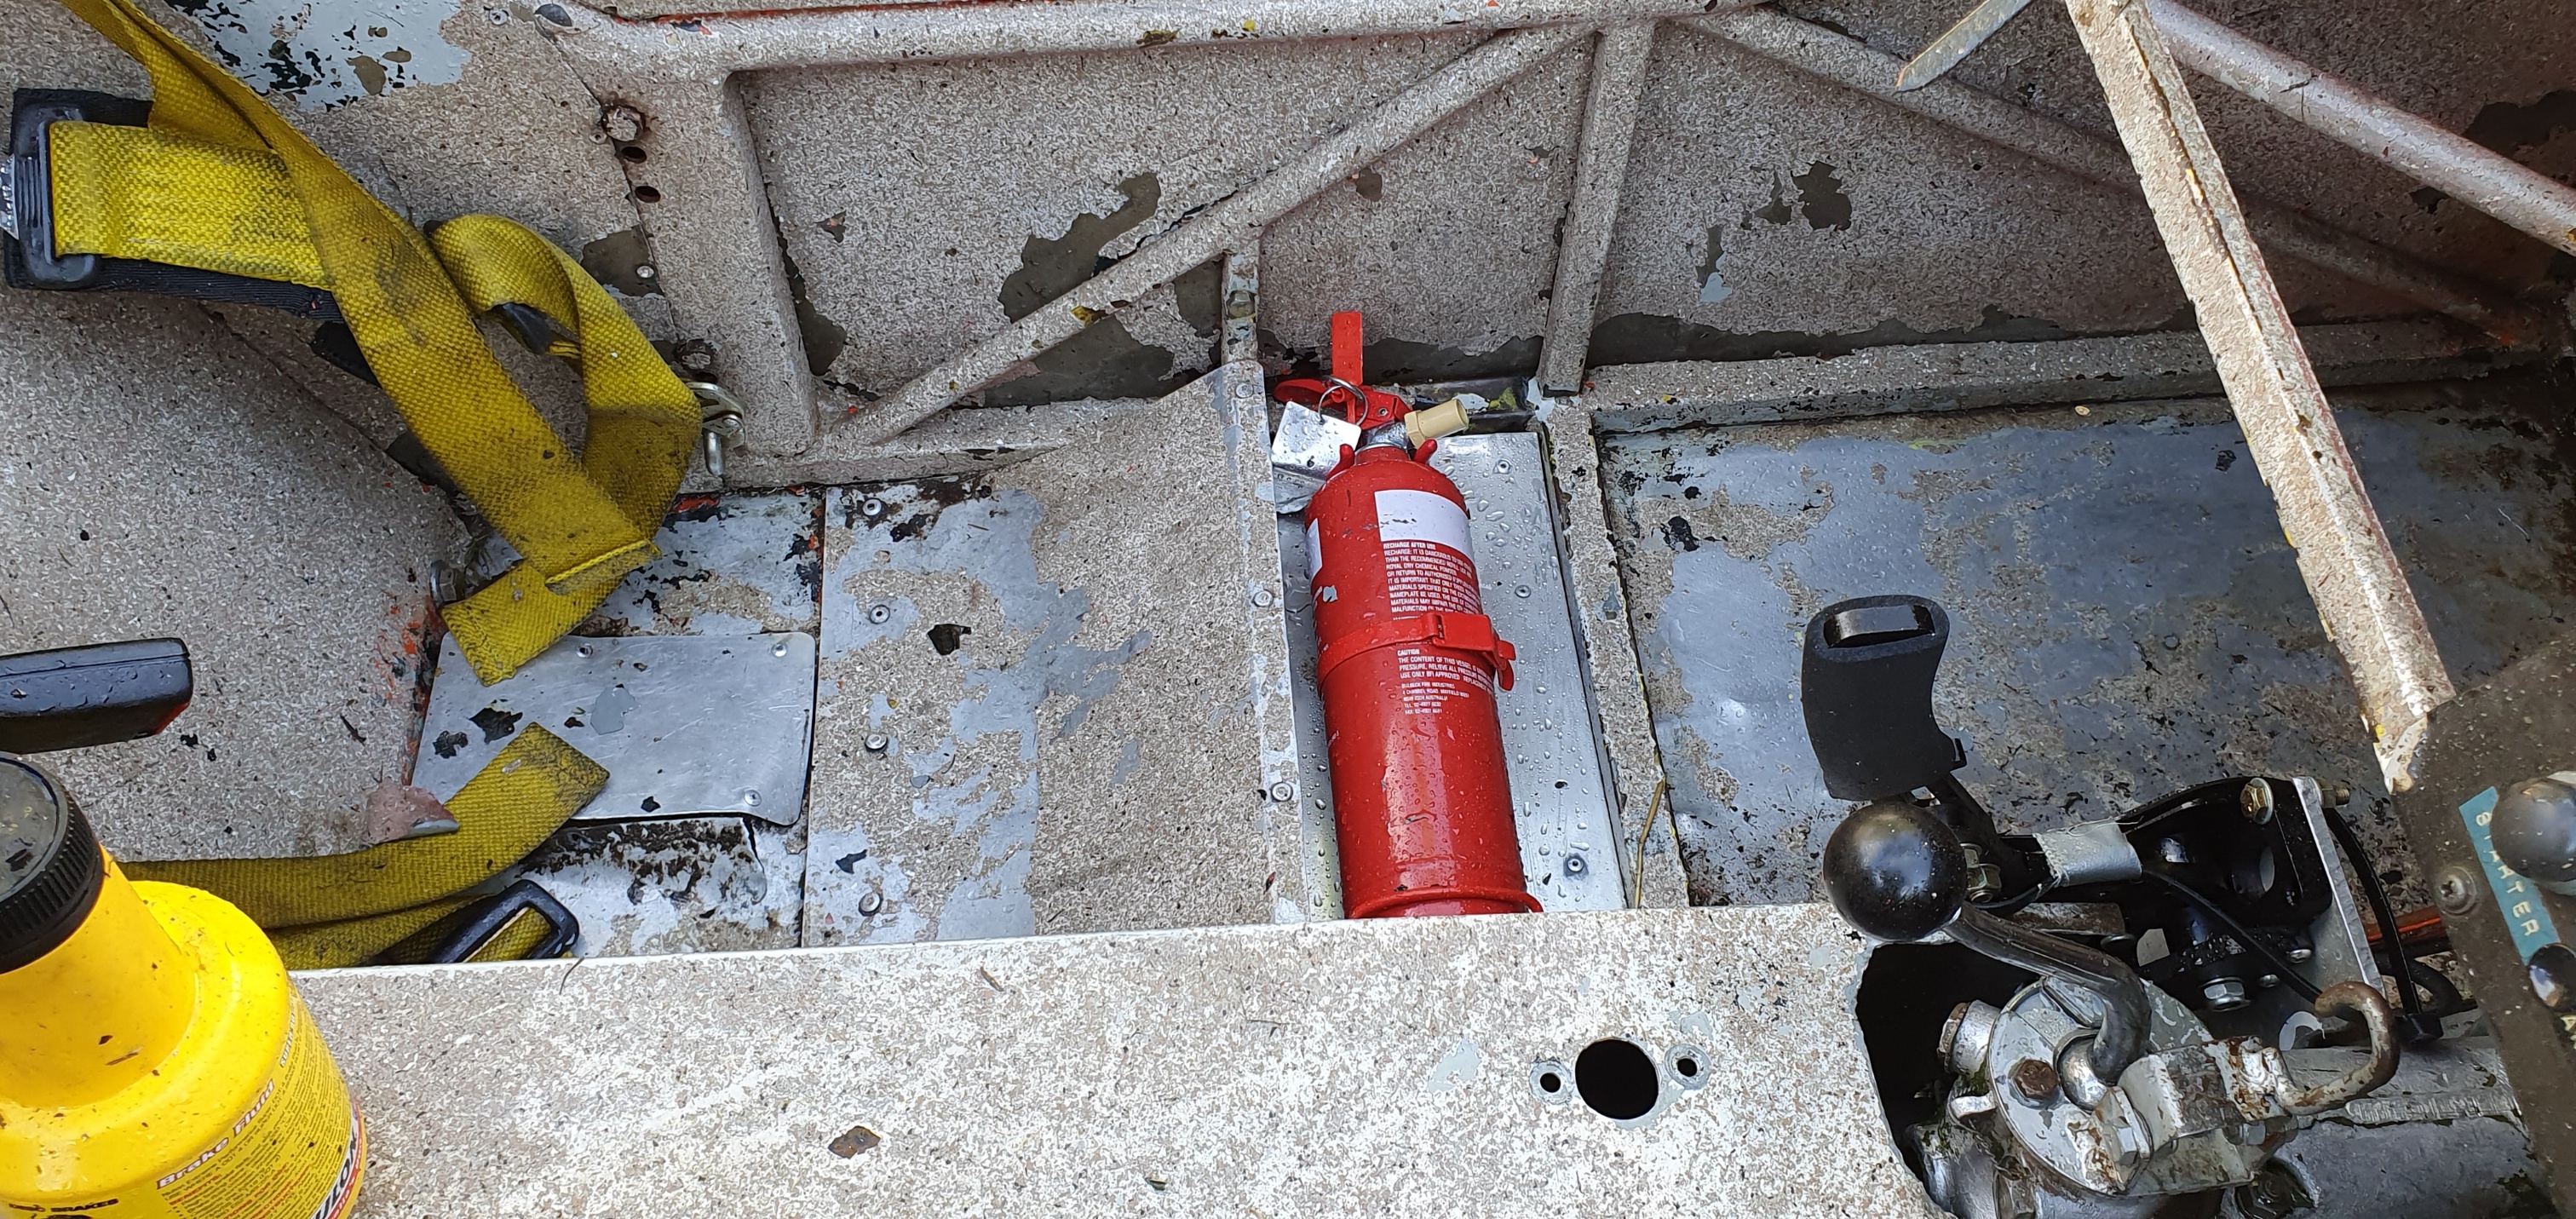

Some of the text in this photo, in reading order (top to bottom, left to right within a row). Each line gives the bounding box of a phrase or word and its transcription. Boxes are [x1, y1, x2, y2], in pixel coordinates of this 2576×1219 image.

[1411, 555, 1446, 566] RECOMMENDED
[1391, 605, 1428, 613] MALFUNCTION
[1428, 663, 1448, 671] RELIEVE
[1448, 664, 1458, 673] ALL
[1456, 659, 1472, 670] VESSEL
[1435, 671, 1460, 680] APPROVED
[156, 1137, 230, 1190] Brake
[233, 1078, 274, 1138] Fluid
[314, 1125, 357, 1219] ULON
